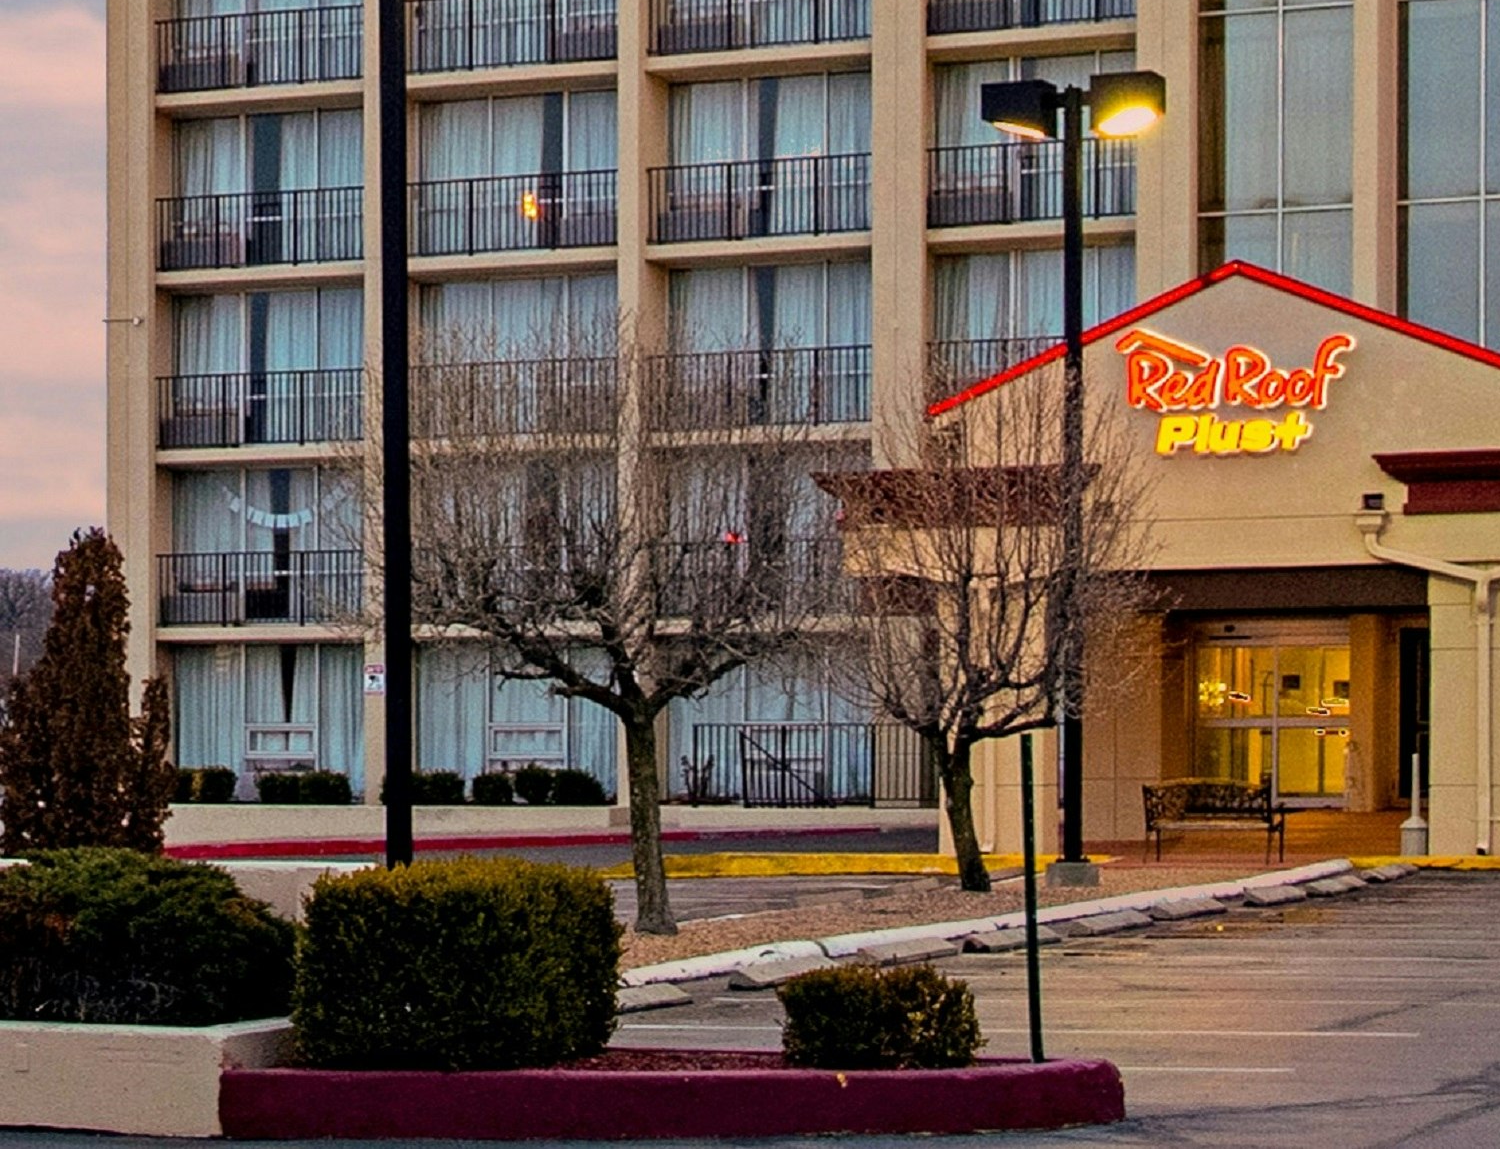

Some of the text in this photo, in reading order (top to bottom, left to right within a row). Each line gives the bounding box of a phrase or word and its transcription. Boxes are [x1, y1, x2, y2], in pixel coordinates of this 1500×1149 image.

[1126, 333, 1356, 412] Red Roof
[1155, 409, 1313, 455] Plus+
